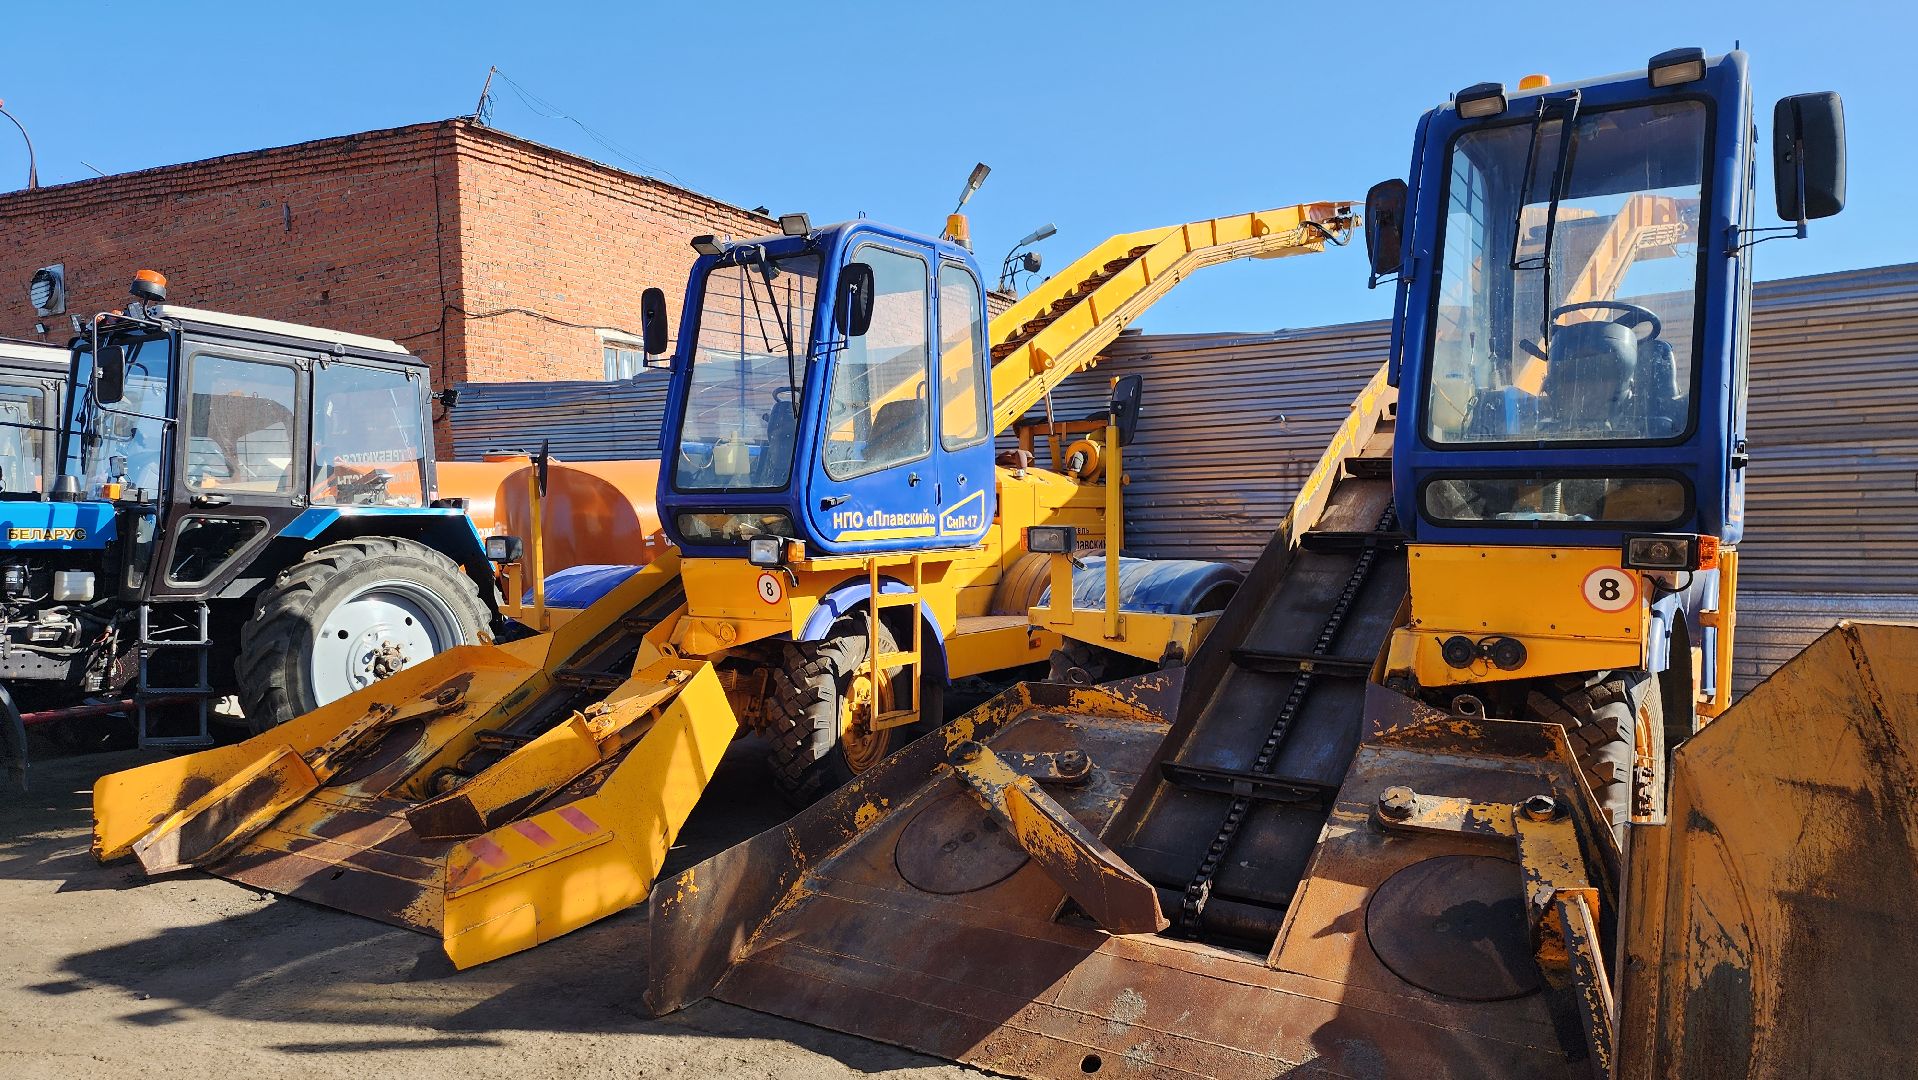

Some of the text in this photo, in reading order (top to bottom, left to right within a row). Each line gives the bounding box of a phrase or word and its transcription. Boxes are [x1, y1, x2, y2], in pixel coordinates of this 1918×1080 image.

[833, 508, 936, 529] НПО «Плавский»
[8, 527, 87, 541] БЕЛАРУС
[765, 582, 774, 597] 8
[1598, 578, 1621, 601] 8
